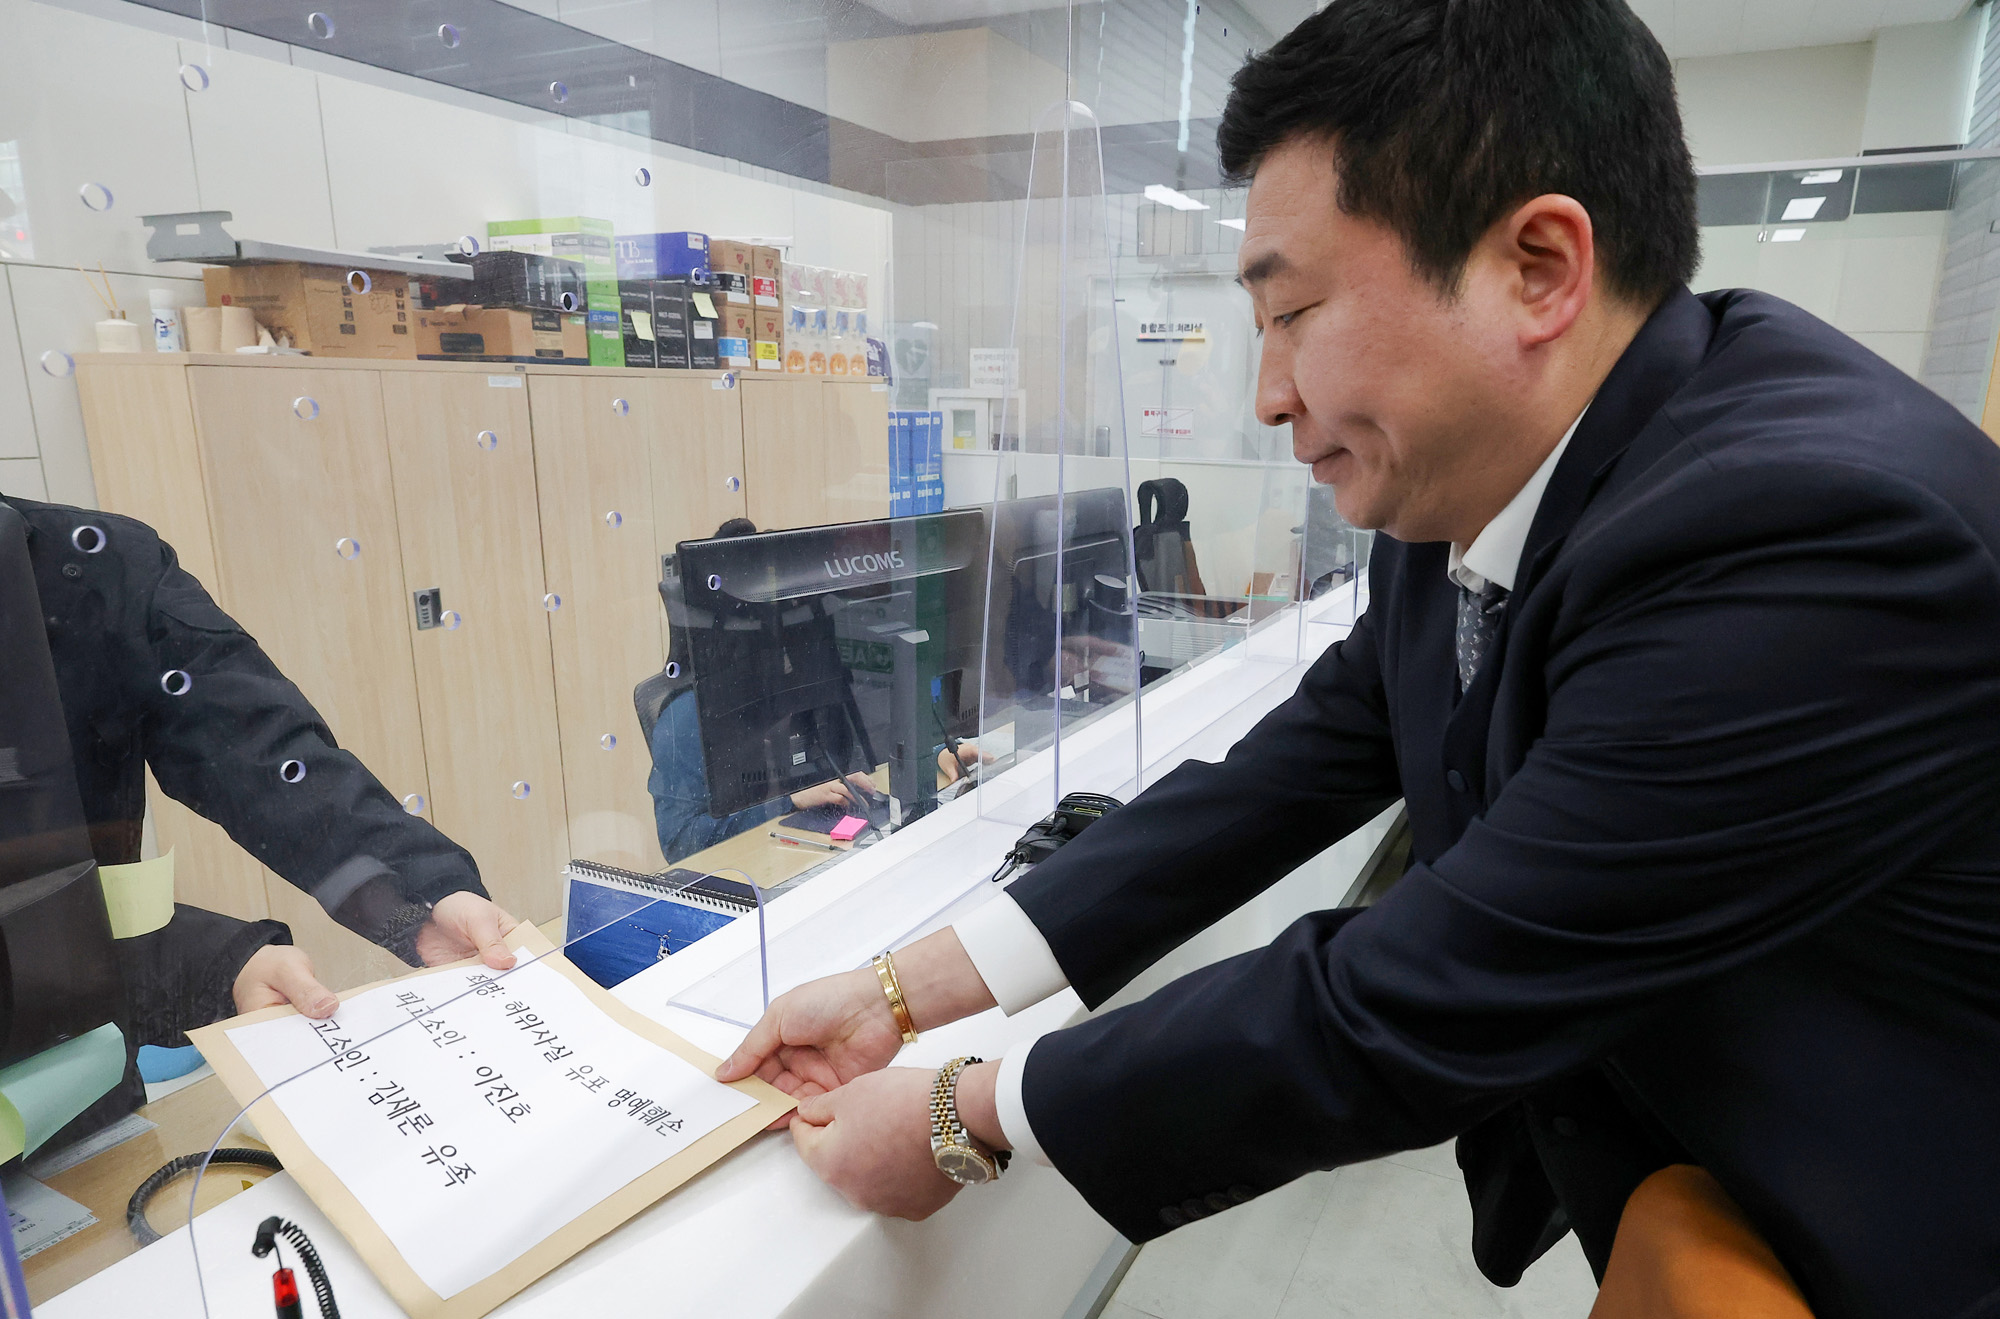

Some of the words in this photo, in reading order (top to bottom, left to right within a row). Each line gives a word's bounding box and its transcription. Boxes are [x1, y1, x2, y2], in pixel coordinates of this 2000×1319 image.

[824, 551, 904, 578] LUCOMS
[309, 1019, 371, 1072] 고소인
[368, 1080, 434, 1136] 김새론
[421, 1144, 476, 1188] 유족
[396, 991, 467, 1048] 피고소인
[474, 1066, 532, 1124] 이진호
[466, 973, 505, 999] 죄명:
[505, 1000, 574, 1063] 허위사실
[565, 1065, 610, 1094] 유포
[608, 1088, 684, 1137] 명예훼손
